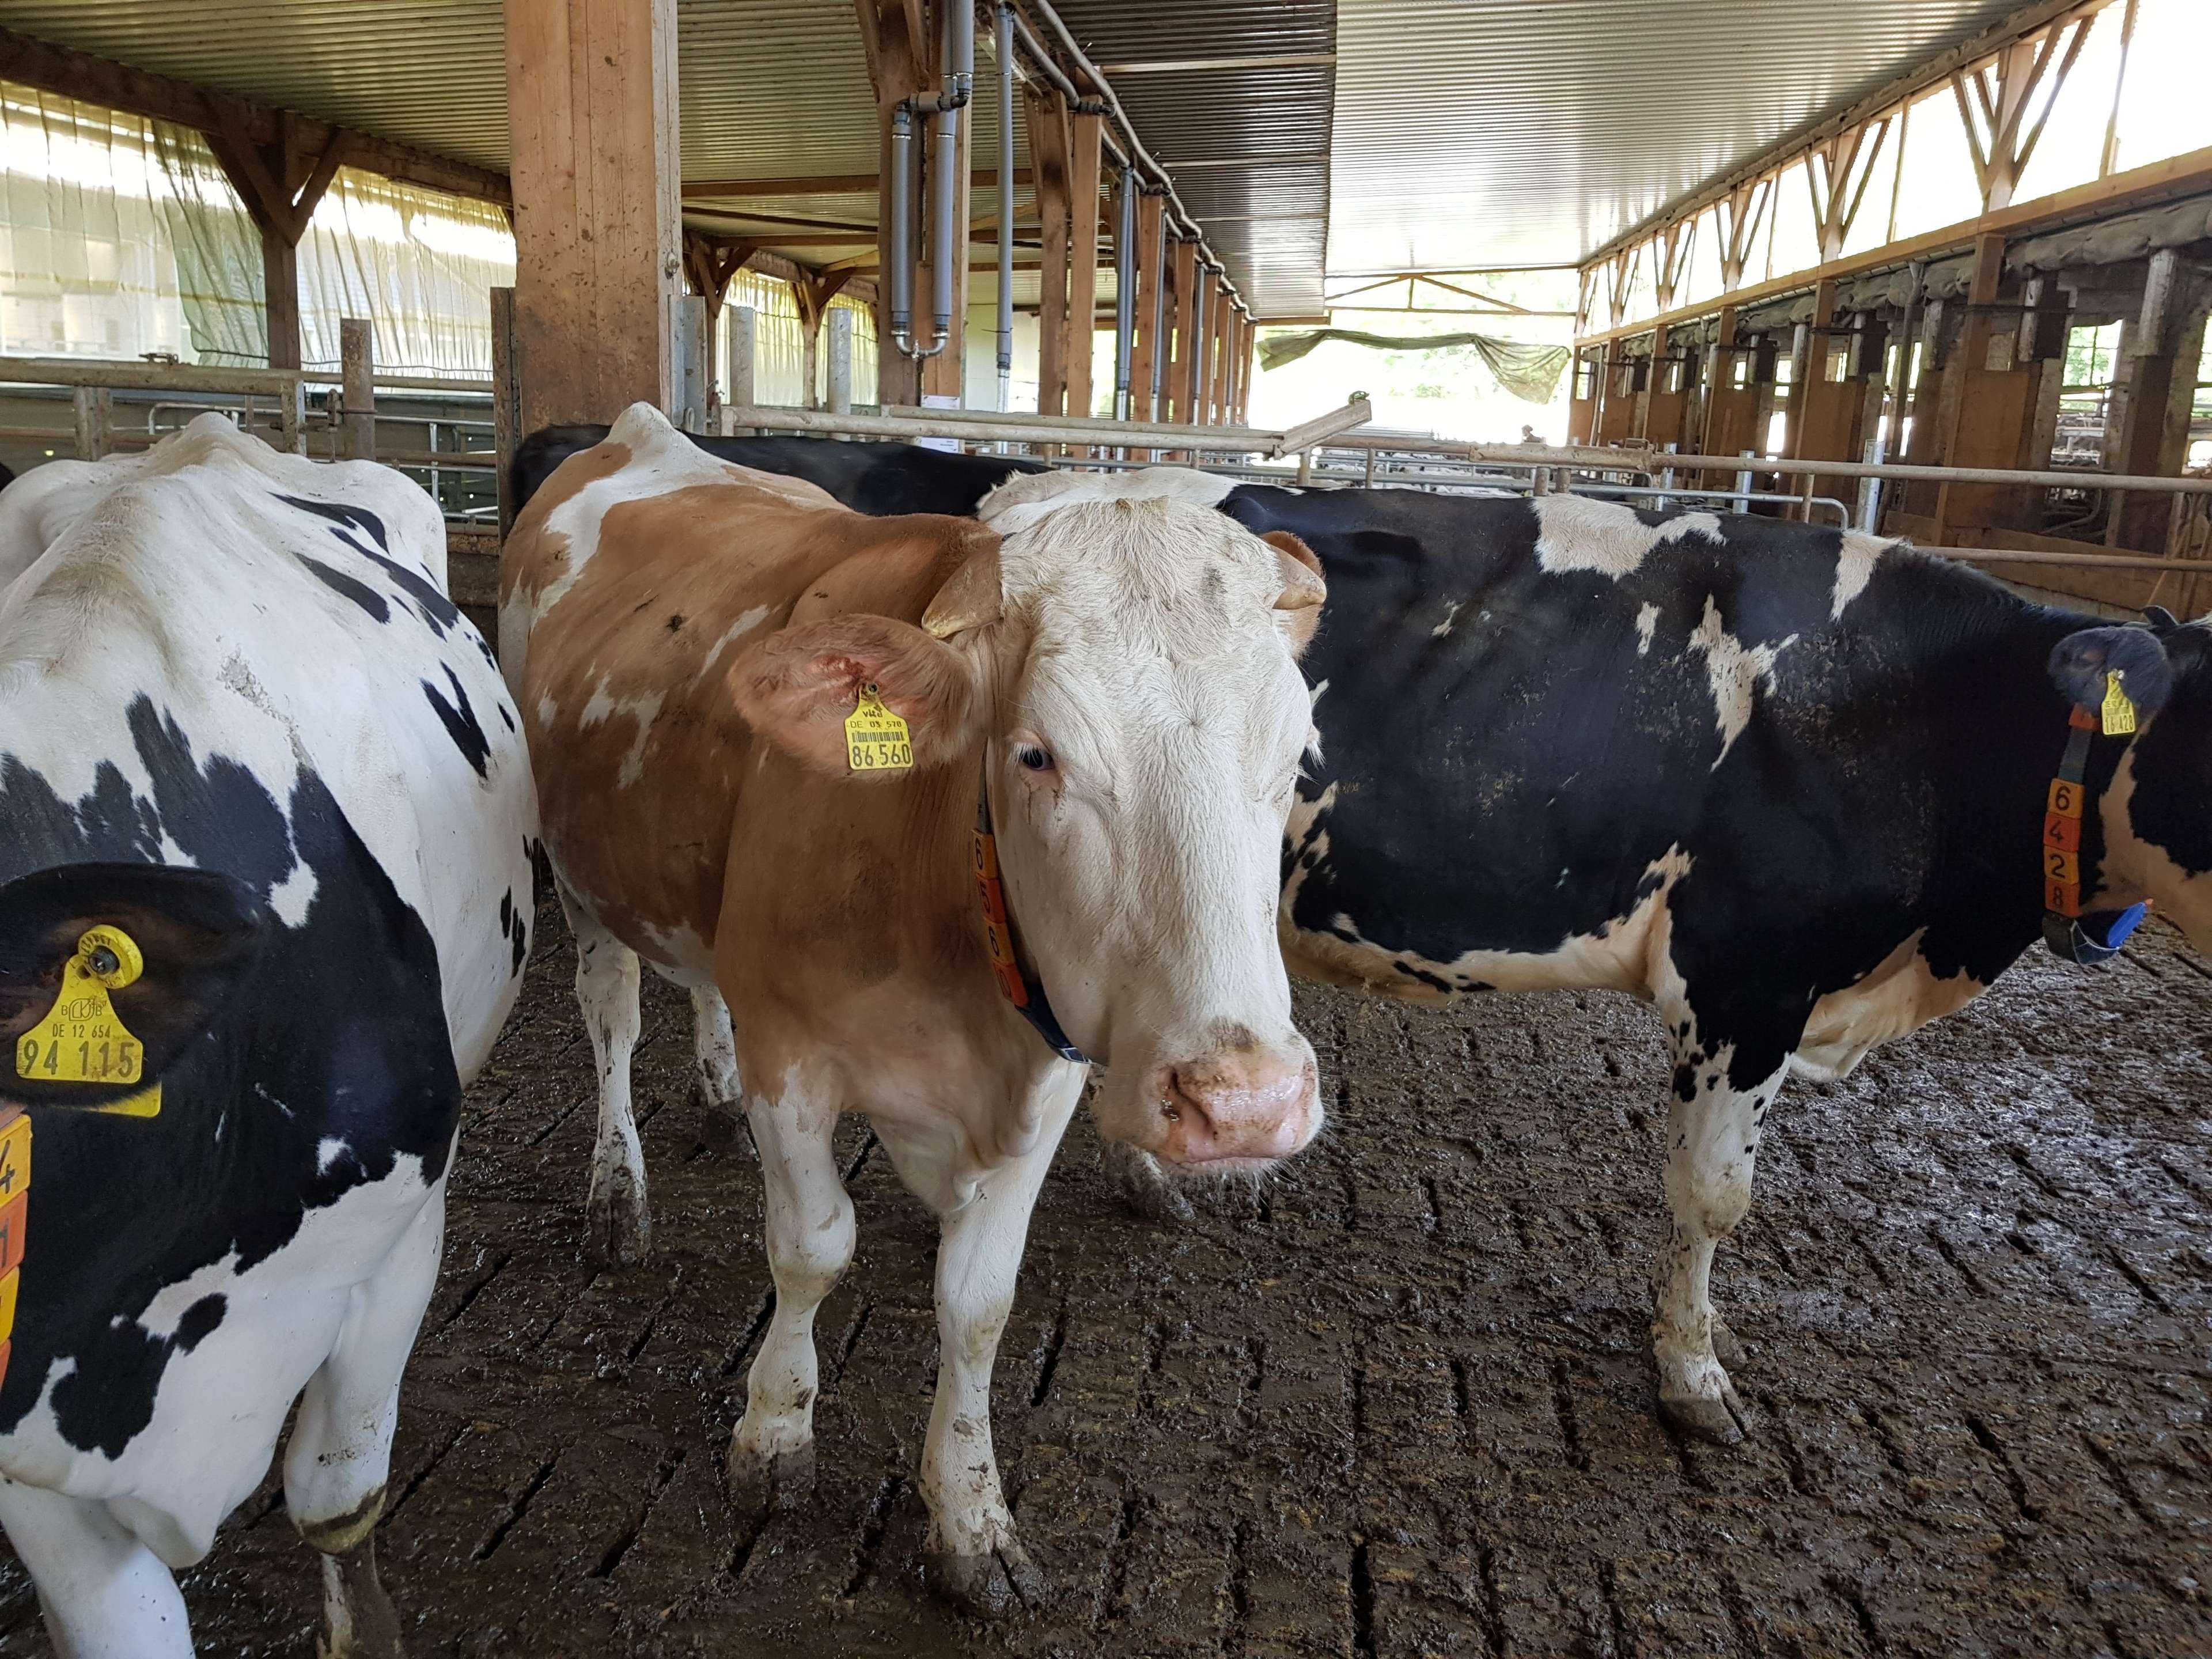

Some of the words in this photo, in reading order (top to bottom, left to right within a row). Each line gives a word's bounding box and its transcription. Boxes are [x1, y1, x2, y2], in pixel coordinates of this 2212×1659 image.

[853, 745, 874, 767] 86
[878, 744, 911, 766] 560
[52, 1024, 65, 1037] DE
[73, 1024, 85, 1037] 12
[92, 1025, 111, 1038] 654
[24, 1039, 58, 1075] 94
[79, 1040, 135, 1078] 115
